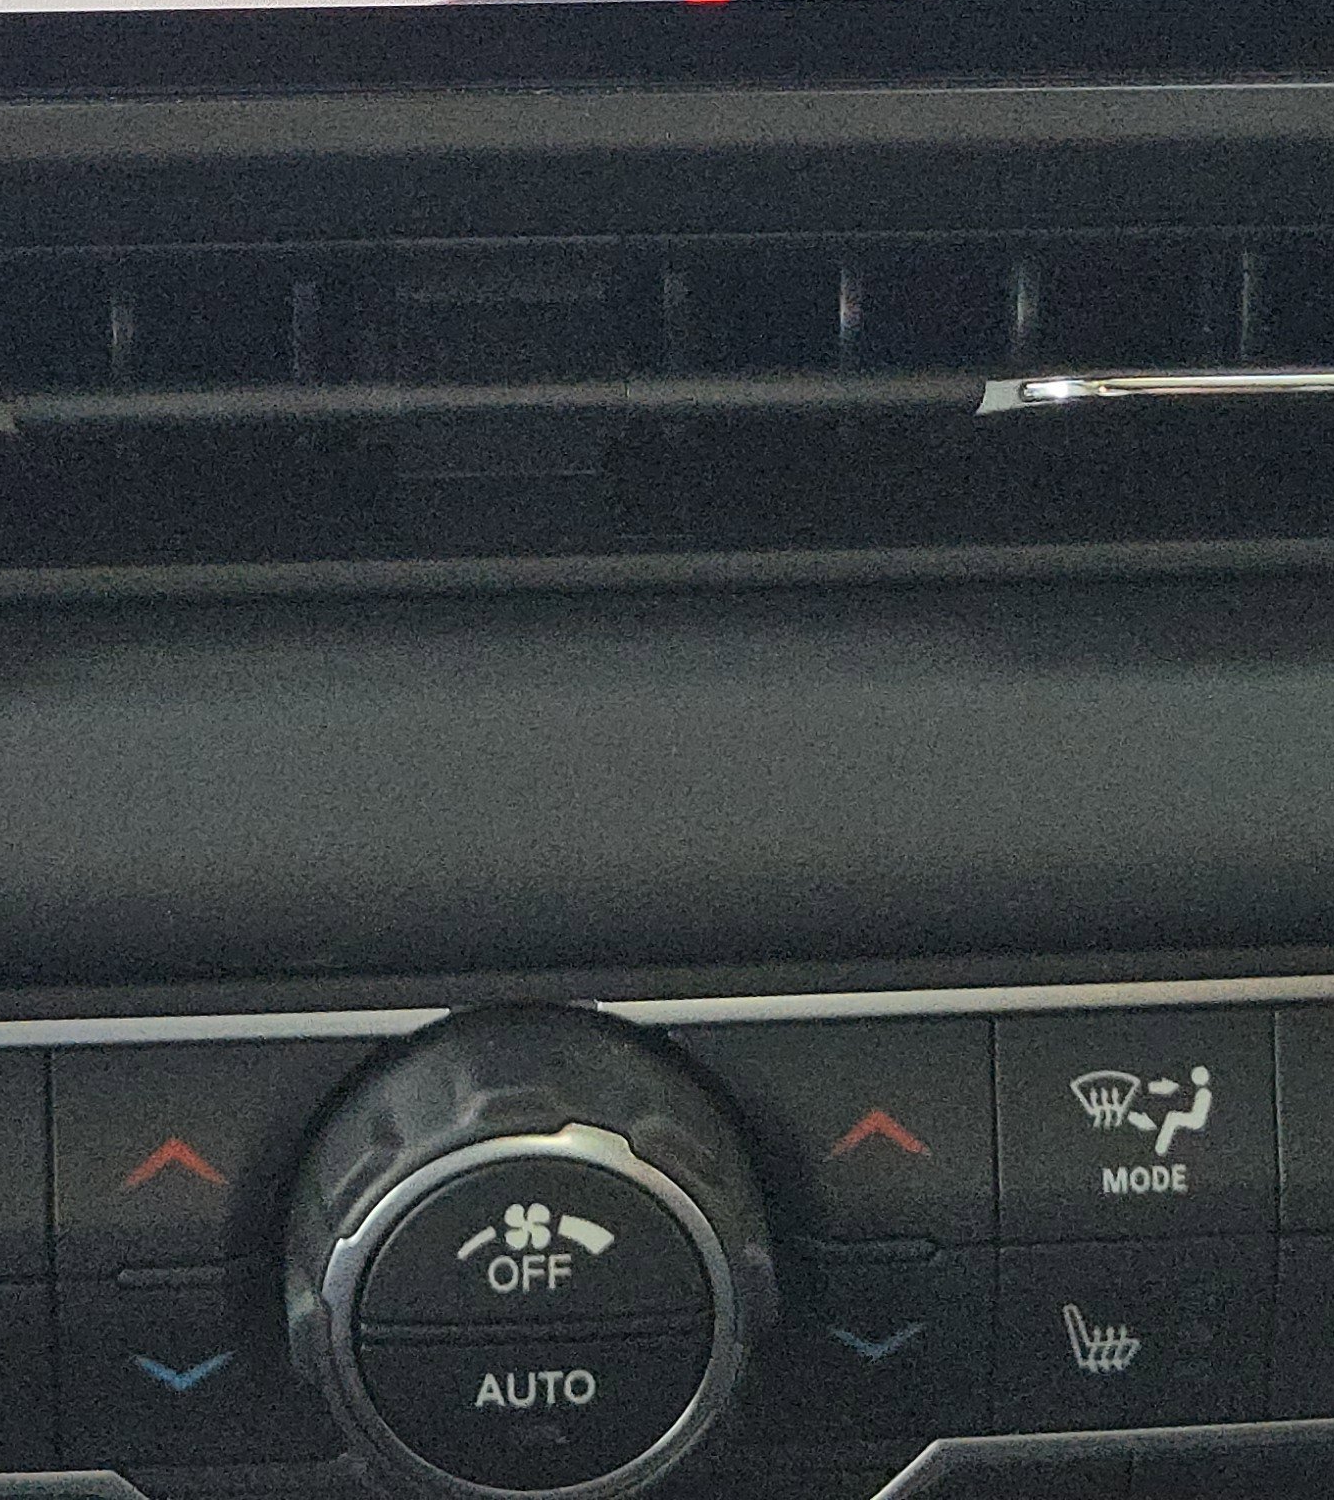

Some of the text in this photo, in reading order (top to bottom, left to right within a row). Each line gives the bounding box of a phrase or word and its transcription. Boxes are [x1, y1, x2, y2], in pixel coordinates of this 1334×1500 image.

[1102, 1163, 1188, 1194] MODE
[488, 1253, 572, 1293] OFF
[475, 1369, 597, 1408] AUTO
